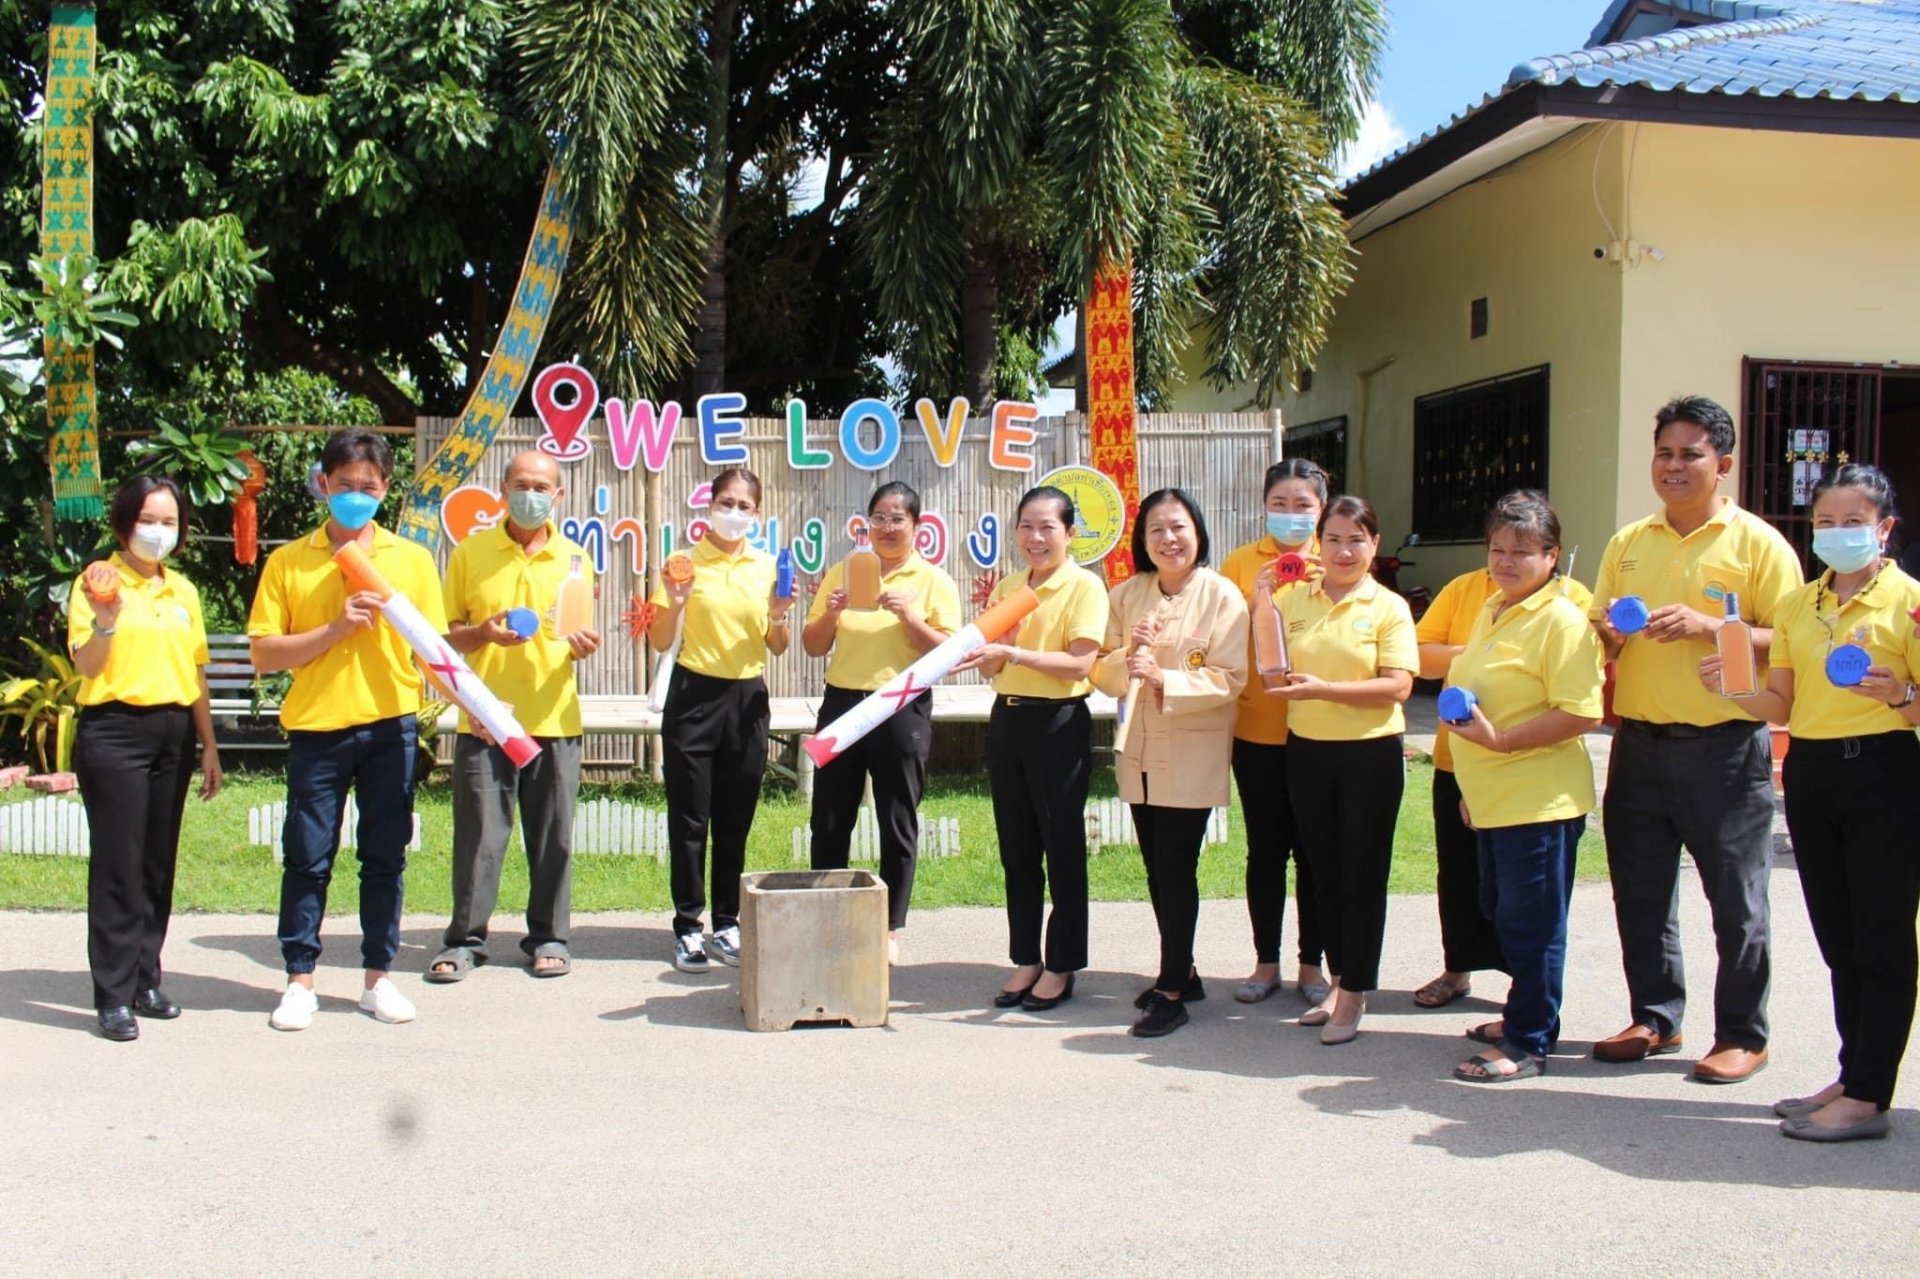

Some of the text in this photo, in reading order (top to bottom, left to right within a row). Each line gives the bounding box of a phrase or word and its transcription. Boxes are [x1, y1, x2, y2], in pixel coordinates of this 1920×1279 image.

[604, 392, 1040, 473] WE LOVE
[1280, 561, 1302, 576] WY
